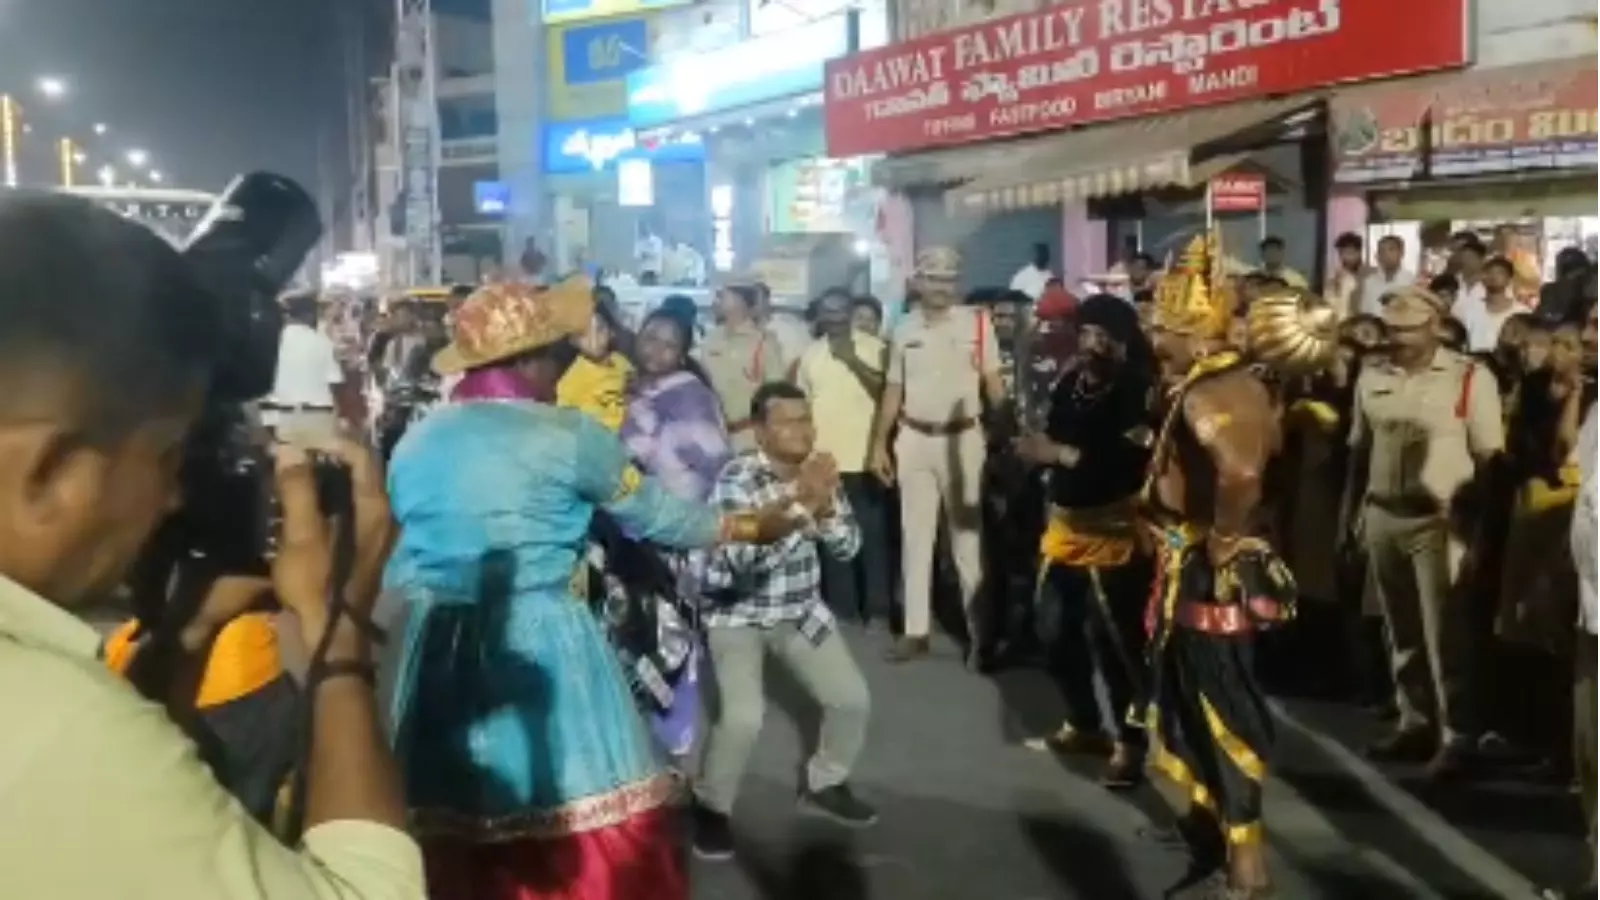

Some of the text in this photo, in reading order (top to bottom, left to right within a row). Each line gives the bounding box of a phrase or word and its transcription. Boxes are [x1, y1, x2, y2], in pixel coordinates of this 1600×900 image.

[833, 0, 1274, 99] DAAWAT FAMILY REST
[1188, 65, 1259, 95] MANDI
